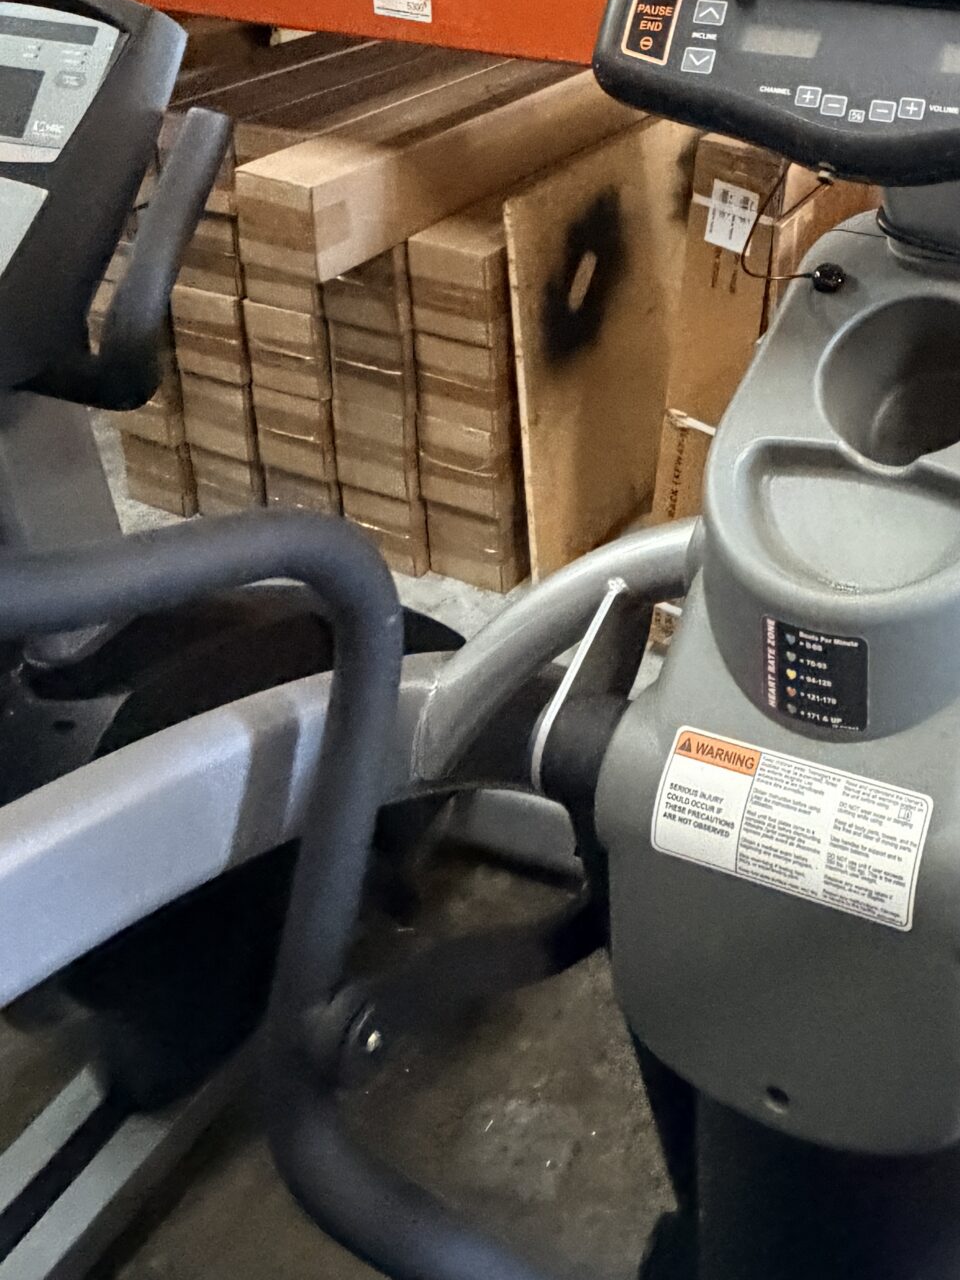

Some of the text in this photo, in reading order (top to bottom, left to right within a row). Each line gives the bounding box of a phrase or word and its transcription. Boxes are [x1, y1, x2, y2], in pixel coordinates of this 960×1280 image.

[636, 3, 674, 18] PAUSE
[639, 20, 663, 32] END
[759, 85, 792, 96] CHANNEL
[929, 104, 960, 115] VOLUME
[766, 618, 777, 709] HEART RATE ZONE
[695, 741, 755, 770] WARNING
[666, 792, 690, 806] COULD
[690, 799, 715, 813] OCCUR
[662, 811, 730, 839] ARE NOT OBSERVED
[664, 802, 735, 830] THESE PRECAUTIONS
